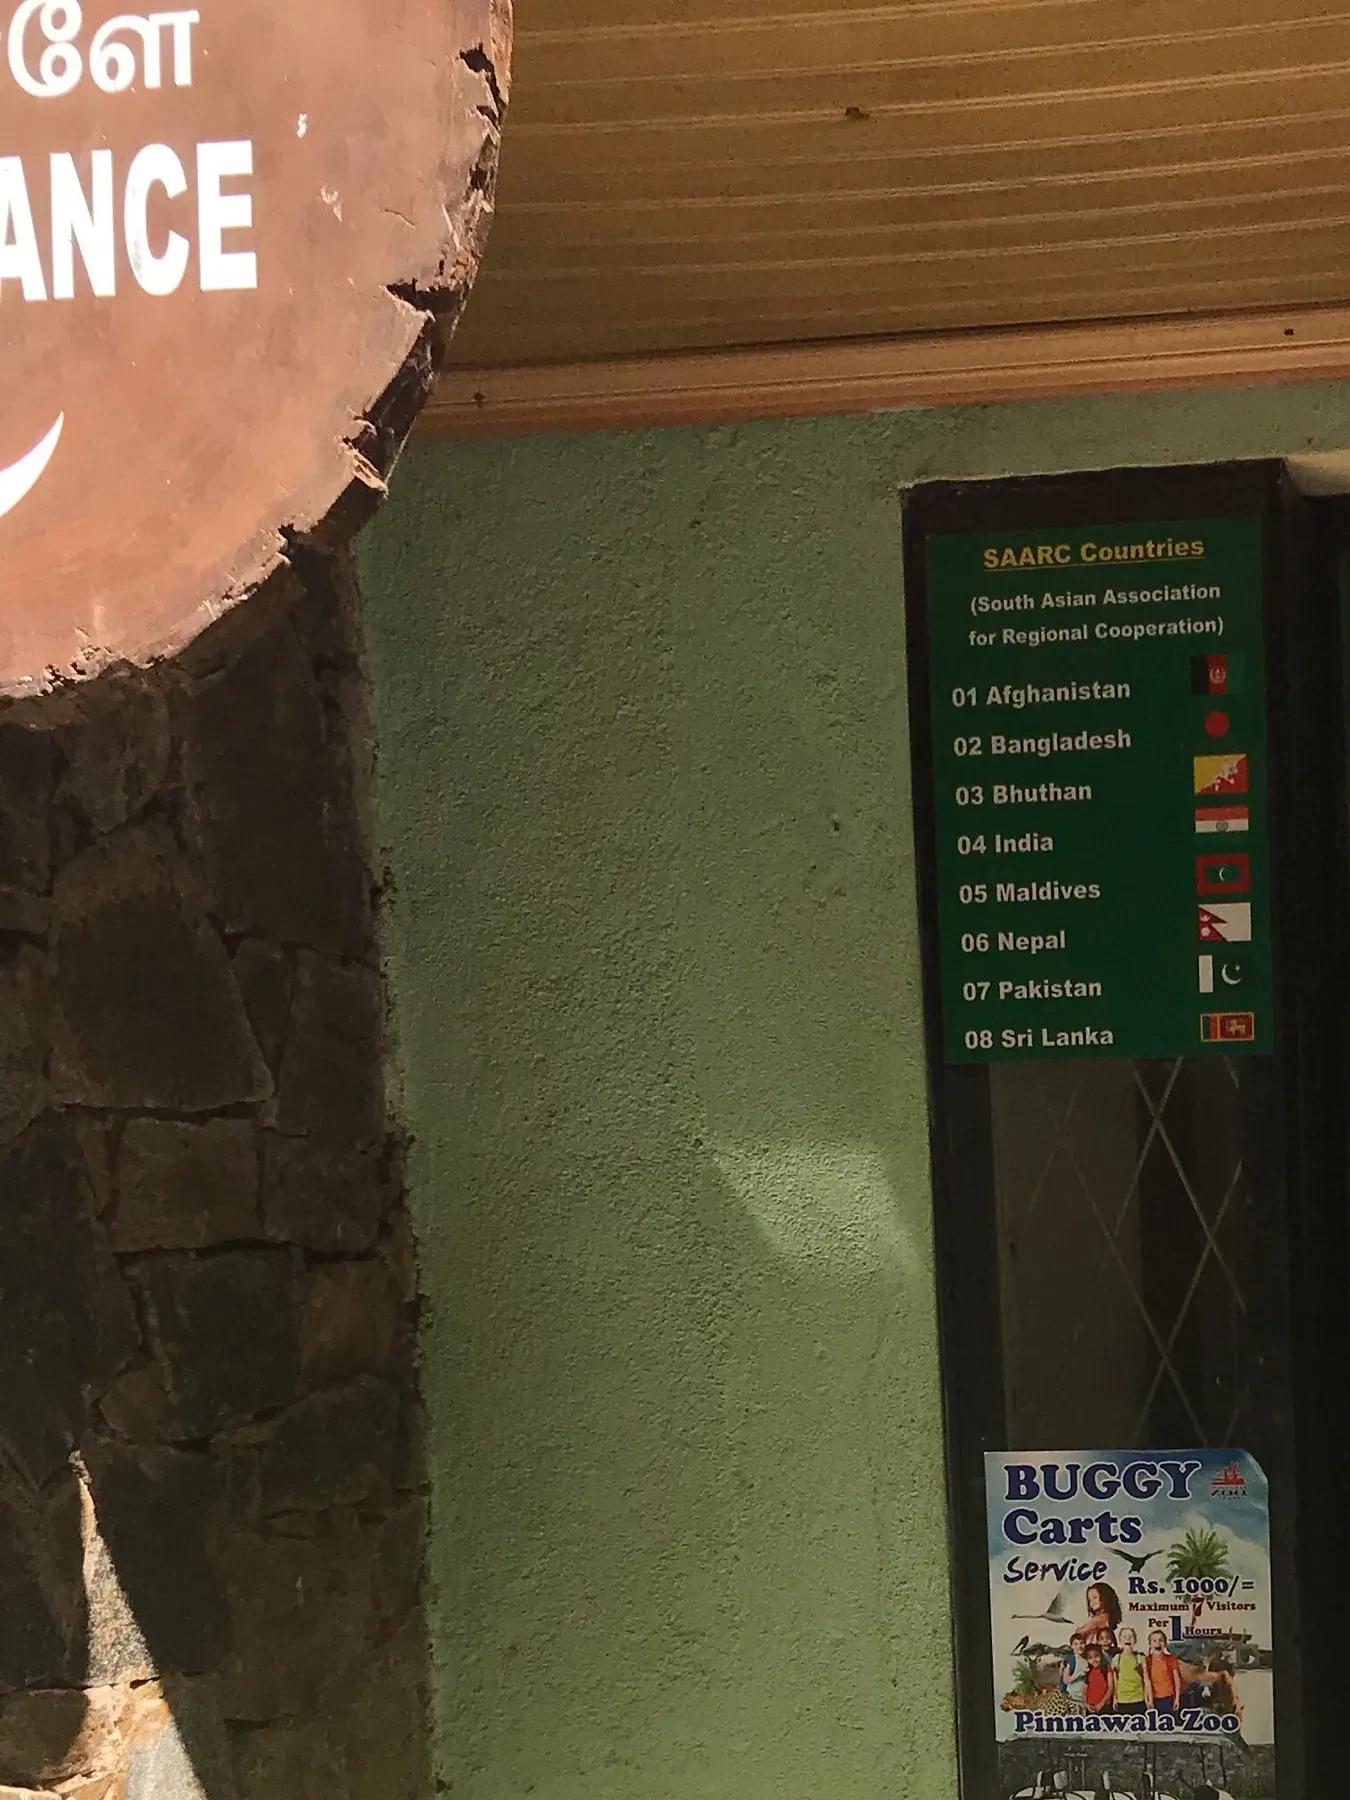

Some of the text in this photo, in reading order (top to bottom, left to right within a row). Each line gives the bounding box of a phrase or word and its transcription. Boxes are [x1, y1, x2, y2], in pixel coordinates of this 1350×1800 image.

[984, 538, 1205, 569] SAARC Countries
[970, 584, 1221, 616] (South Asian Association
[968, 617, 1224, 646] for Regional Cooperation)
[951, 681, 1131, 709] 01 Afghanistan
[953, 729, 1132, 757] 02 Bangladesh
[955, 783, 1092, 806] 03 Bhuthan
[957, 834, 1054, 855] 04 India
[959, 881, 1100, 904] 05 Maldives
[961, 930, 1066, 954] 06 Nepal
[963, 979, 1102, 1001] 07 Pakistan
[965, 1027, 1114, 1049] 08 Sri Lanka
[1004, 1462, 1201, 1502] BUGGY
[1003, 1508, 1142, 1546] Carts
[1003, 1555, 1108, 1584] Service
[1128, 1575, 1255, 1598] Rs. 1000/=
[1128, 1602, 1190, 1612] Maximum
[1207, 1601, 1256, 1611] Visitors
[1148, 1618, 1169, 1628] Per
[1185, 1626, 1223, 1636] Hours
[1014, 1709, 1239, 1734] Pinnawala Zoo
